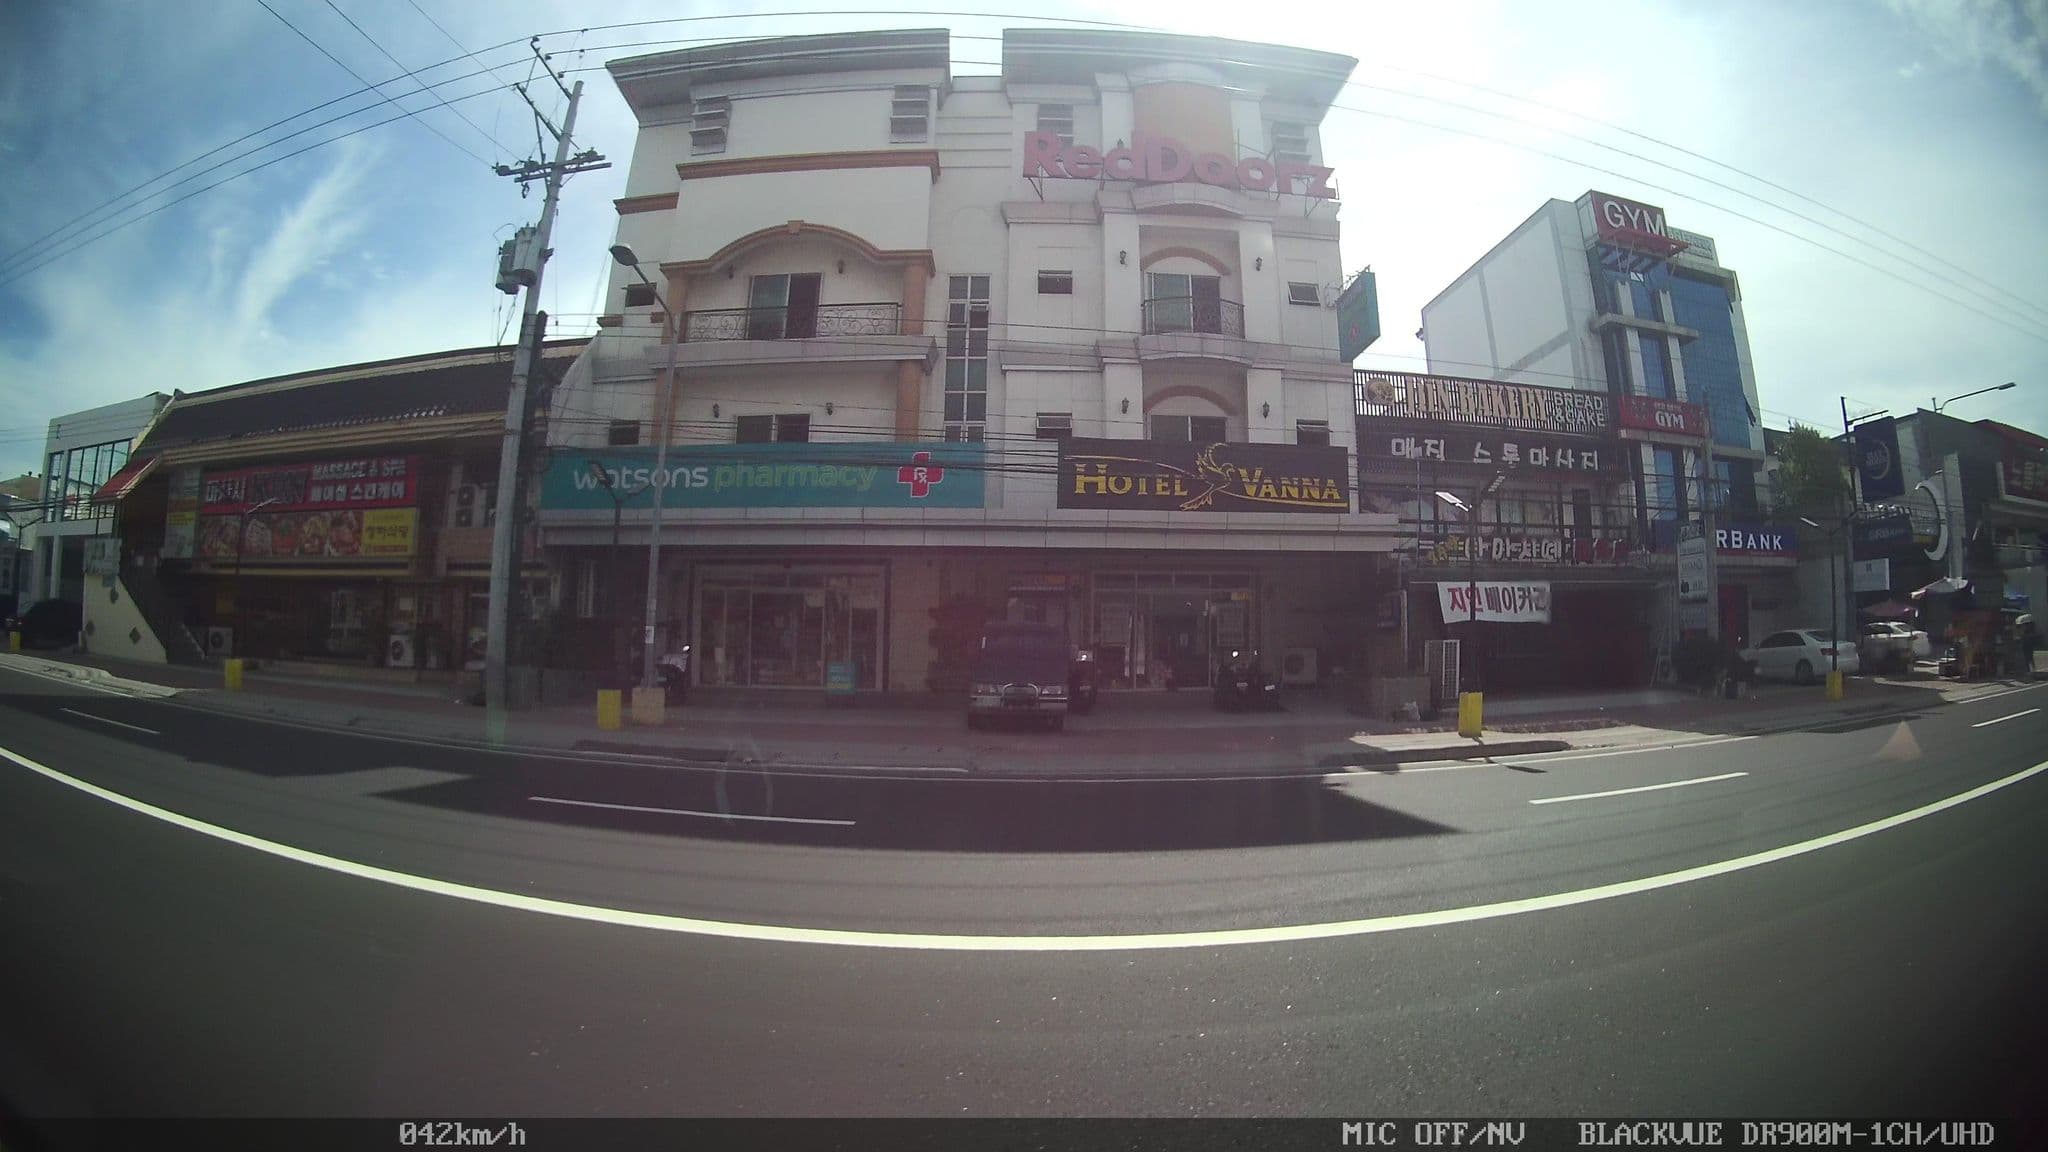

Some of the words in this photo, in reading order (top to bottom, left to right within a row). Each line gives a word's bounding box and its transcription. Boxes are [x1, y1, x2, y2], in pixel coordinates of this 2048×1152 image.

[1023, 129, 1337, 200] RedDoorz
[1603, 200, 1666, 237] GYM
[1454, 380, 1549, 421] BAKERY
[1554, 392, 1604, 411] BREAD
[1655, 410, 1685, 430] GYM
[1391, 437, 1445, 462] 매직
[573, 463, 708, 489] watsons
[714, 460, 879, 492] pharmacy
[1074, 463, 1188, 496] HOTEL
[1237, 467, 1341, 499] VANNA
